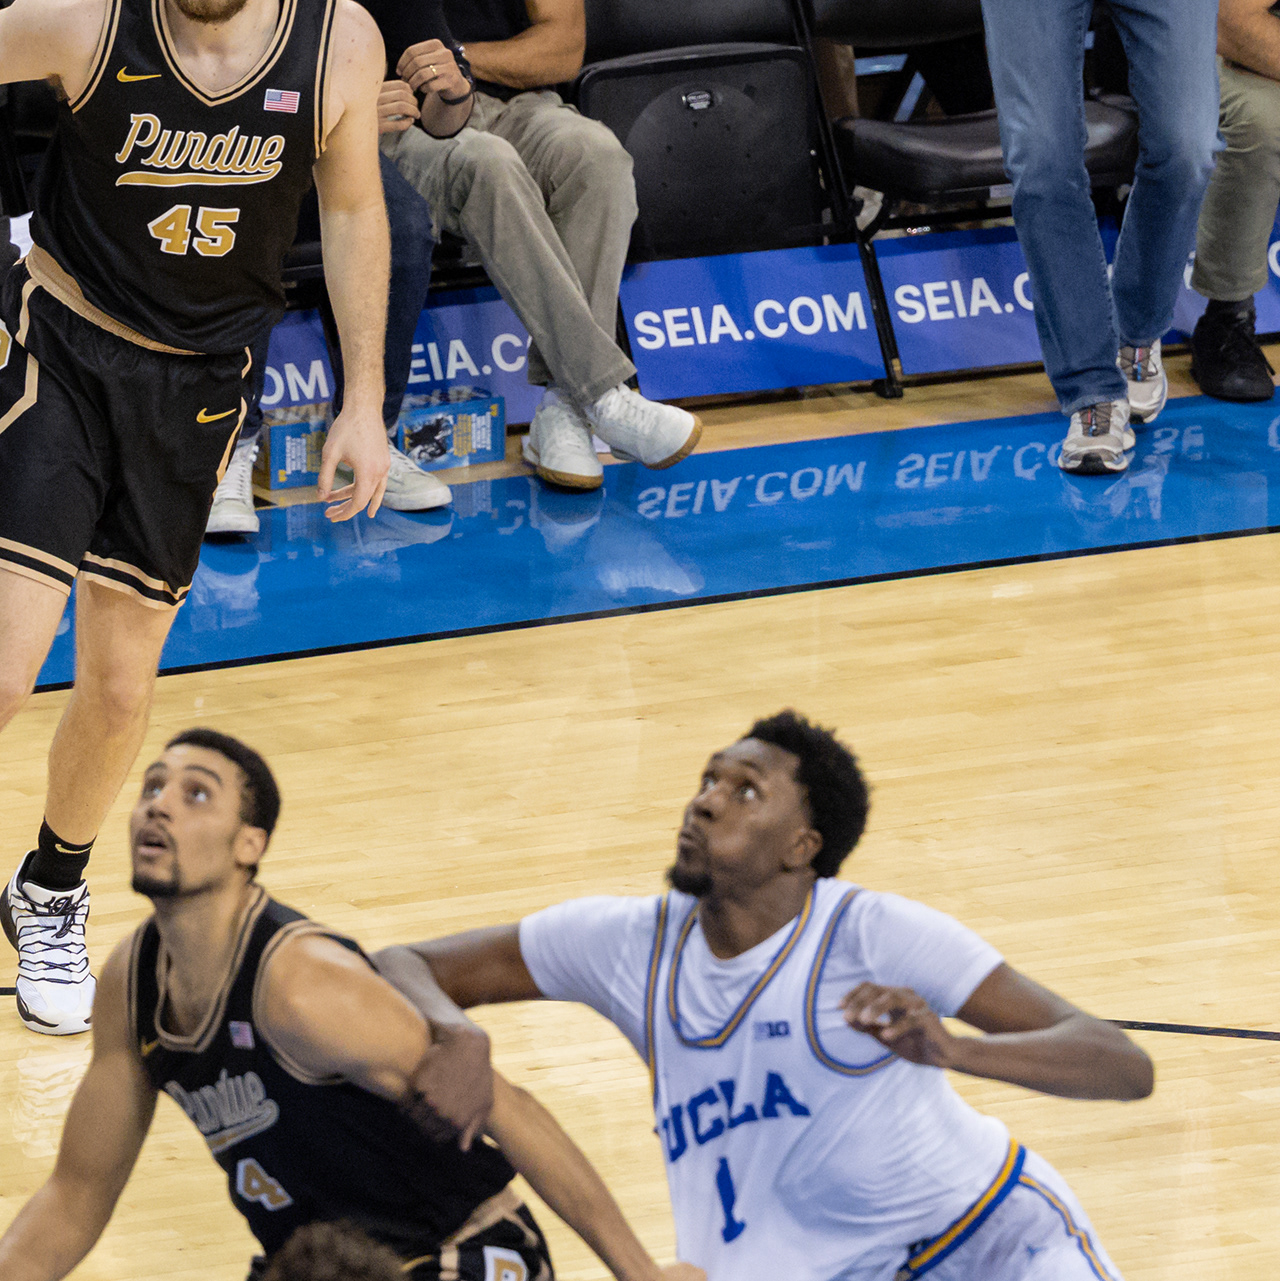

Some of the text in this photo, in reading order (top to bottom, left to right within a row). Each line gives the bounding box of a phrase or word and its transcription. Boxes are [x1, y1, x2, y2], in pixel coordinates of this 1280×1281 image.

[115, 112, 286, 187] Purdue
[147, 204, 241, 257] 45
[633, 291, 869, 350] SEIA.COM
[654, 1070, 812, 1163] UCLA
[235, 1157, 295, 1212] 4
[715, 1156, 747, 1244] 1
